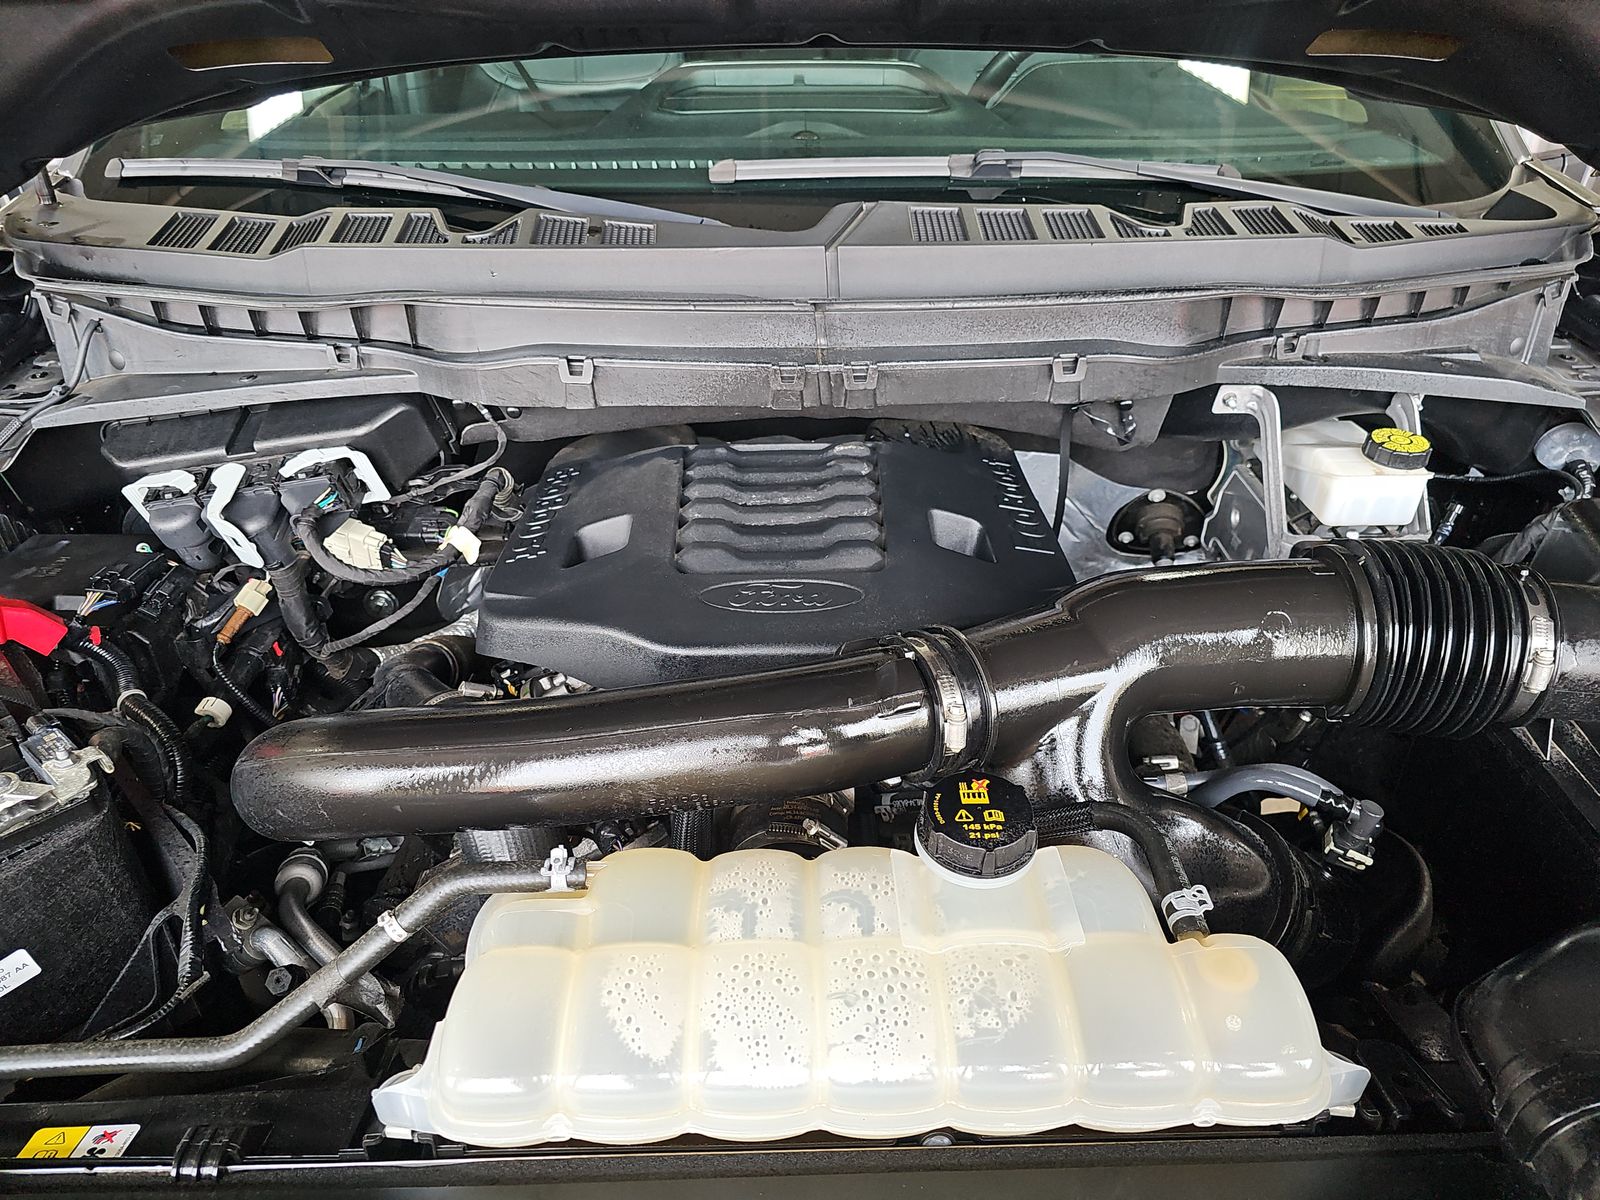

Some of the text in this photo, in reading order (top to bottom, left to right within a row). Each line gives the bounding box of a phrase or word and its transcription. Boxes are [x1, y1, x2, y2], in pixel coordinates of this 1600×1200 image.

[727, 583, 834, 607] Ford
[962, 823, 1003, 831] 145 kPa
[984, 832, 1000, 840] psi
[0, 972, 11, 982] 87
[15, 963, 29, 973] AA
